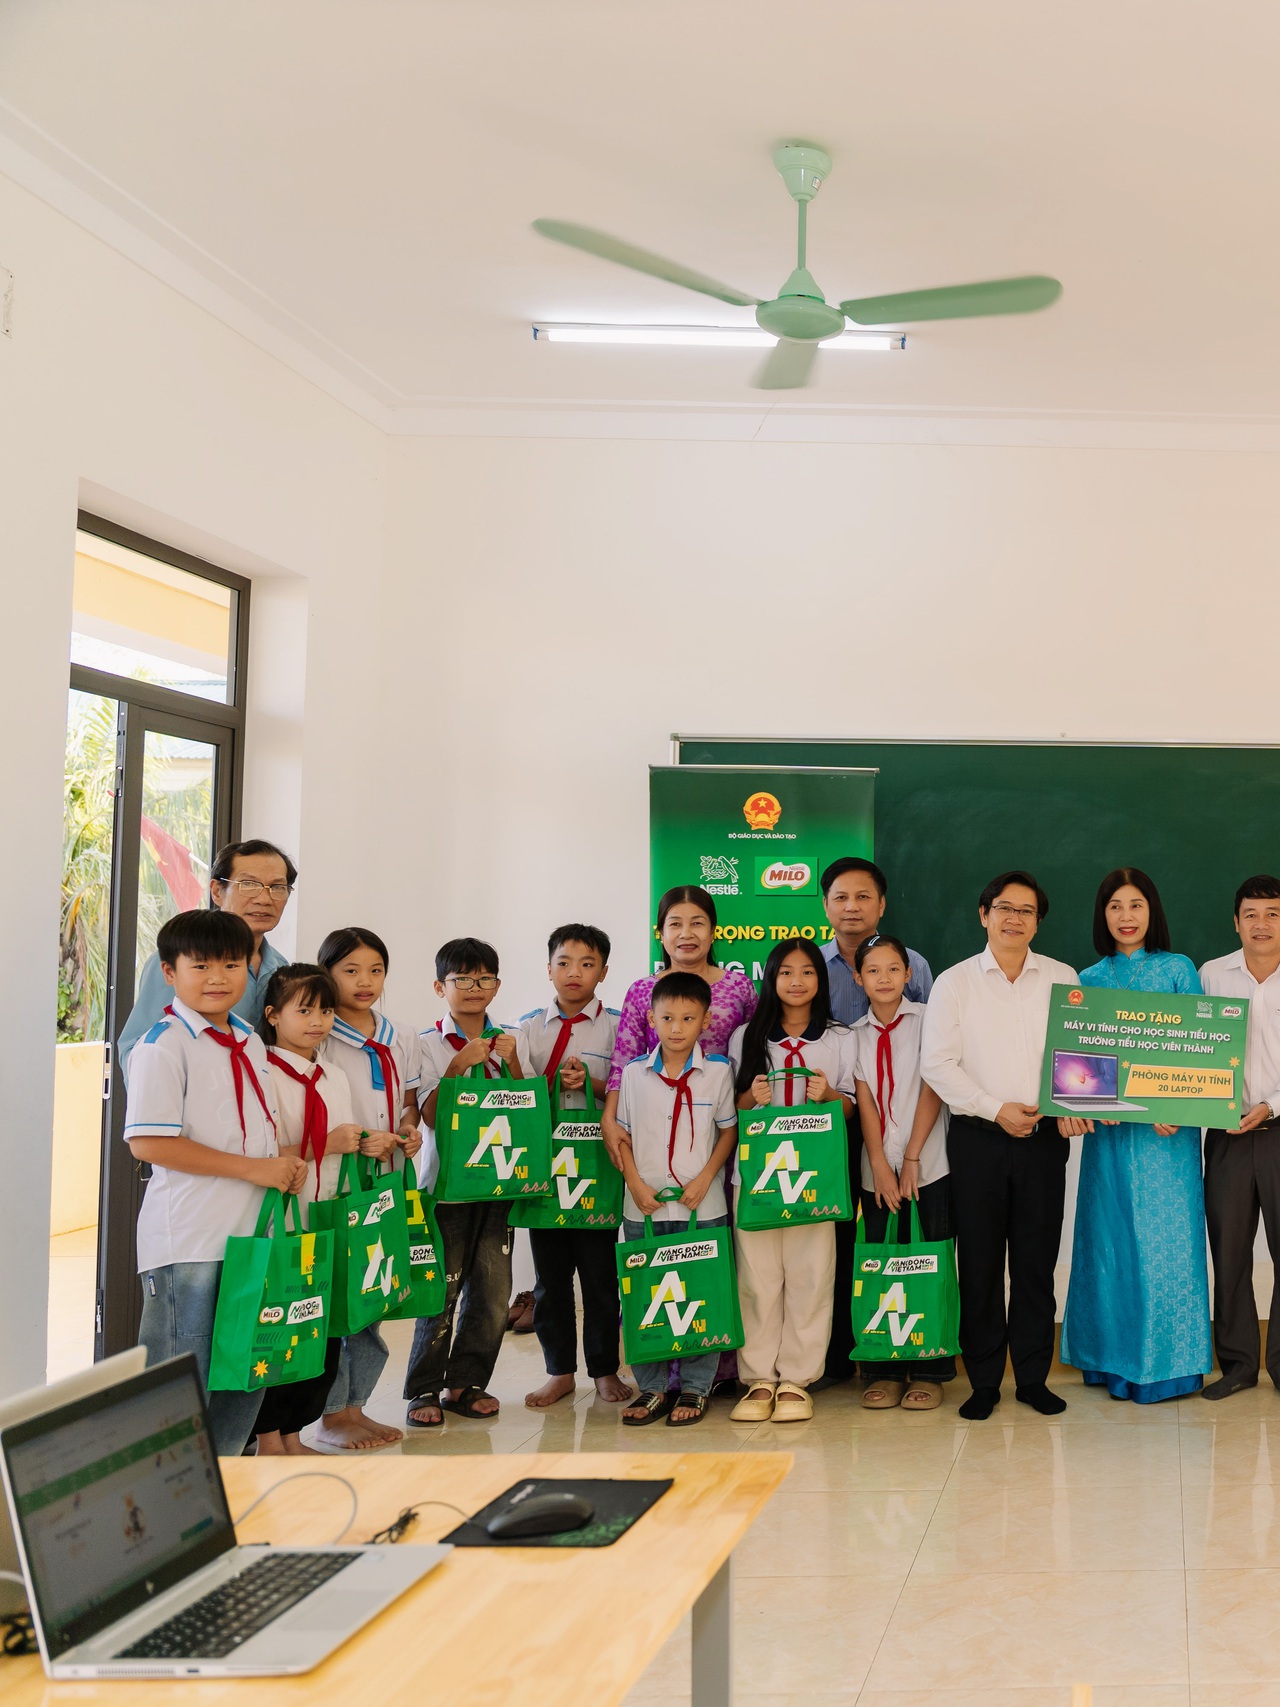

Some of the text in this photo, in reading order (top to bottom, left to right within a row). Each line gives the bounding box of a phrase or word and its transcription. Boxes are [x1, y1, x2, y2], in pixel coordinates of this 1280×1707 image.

[769, 870, 805, 881] MILO
[714, 925, 765, 944] RỌNG
[769, 925, 815, 940] TRAO
[1116, 1010, 1182, 1025] TRAO TẶNG
[1064, 1020, 1231, 1043] MÁY VI TÍNH CHO HỌC SINH TIỂU HỌC
[1078, 1035, 1214, 1053] TRƯỜNG TIỂU HỌC VIÊN THÀNH
[1132, 1069, 1231, 1085] PHÒNG MÁY VI TÍNH
[1171, 1085, 1203, 1094] LAPTOP
